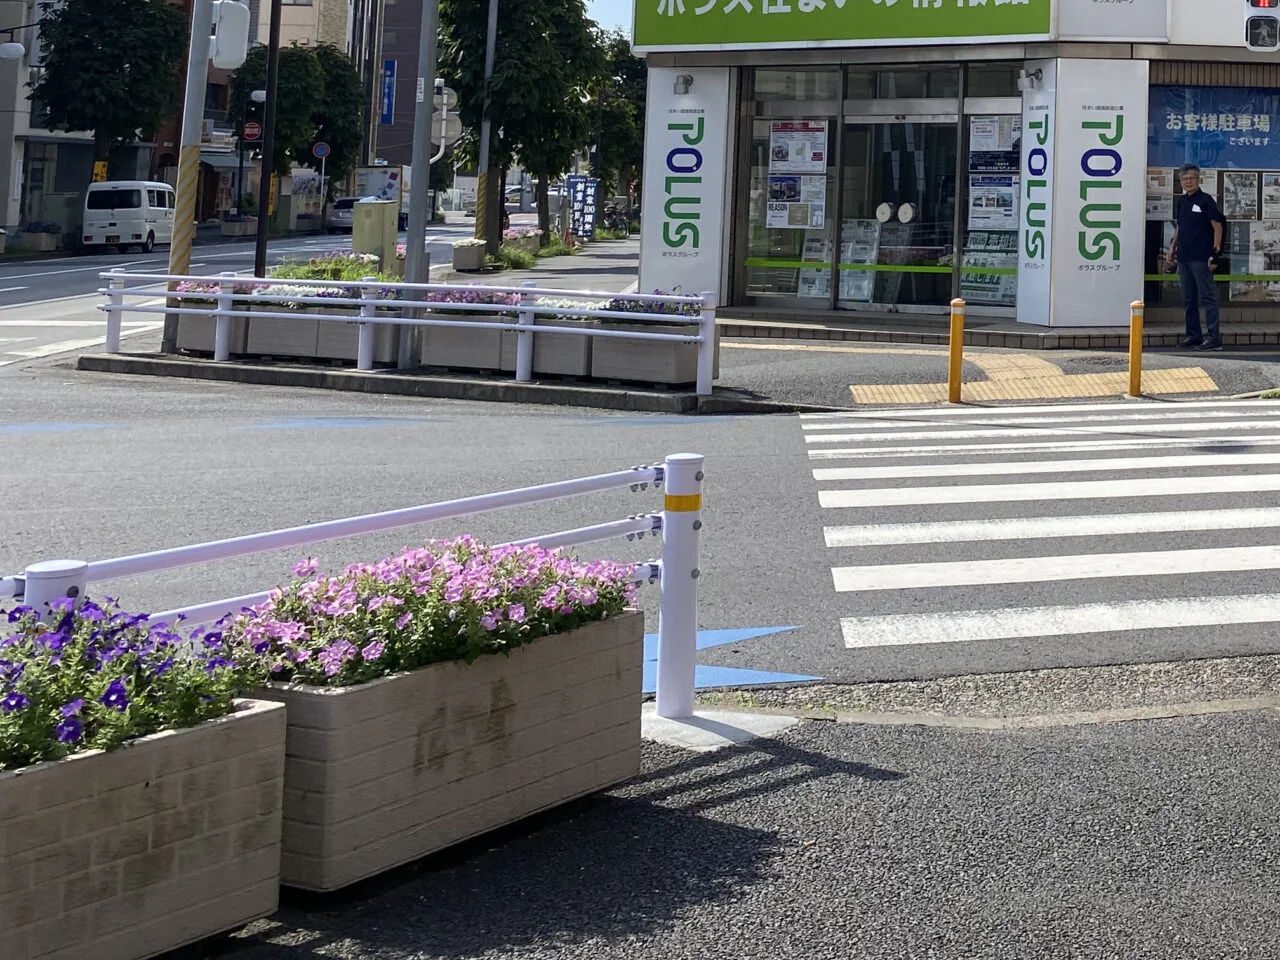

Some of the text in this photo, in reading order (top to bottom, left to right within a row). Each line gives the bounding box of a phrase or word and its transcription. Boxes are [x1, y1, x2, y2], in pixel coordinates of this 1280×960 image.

[662, 117, 705, 249] POLUS
[1025, 114, 1049, 260] POLUS
[1078, 114, 1124, 261] POLUS
[1166, 113, 1271, 133] お客様駐車場
